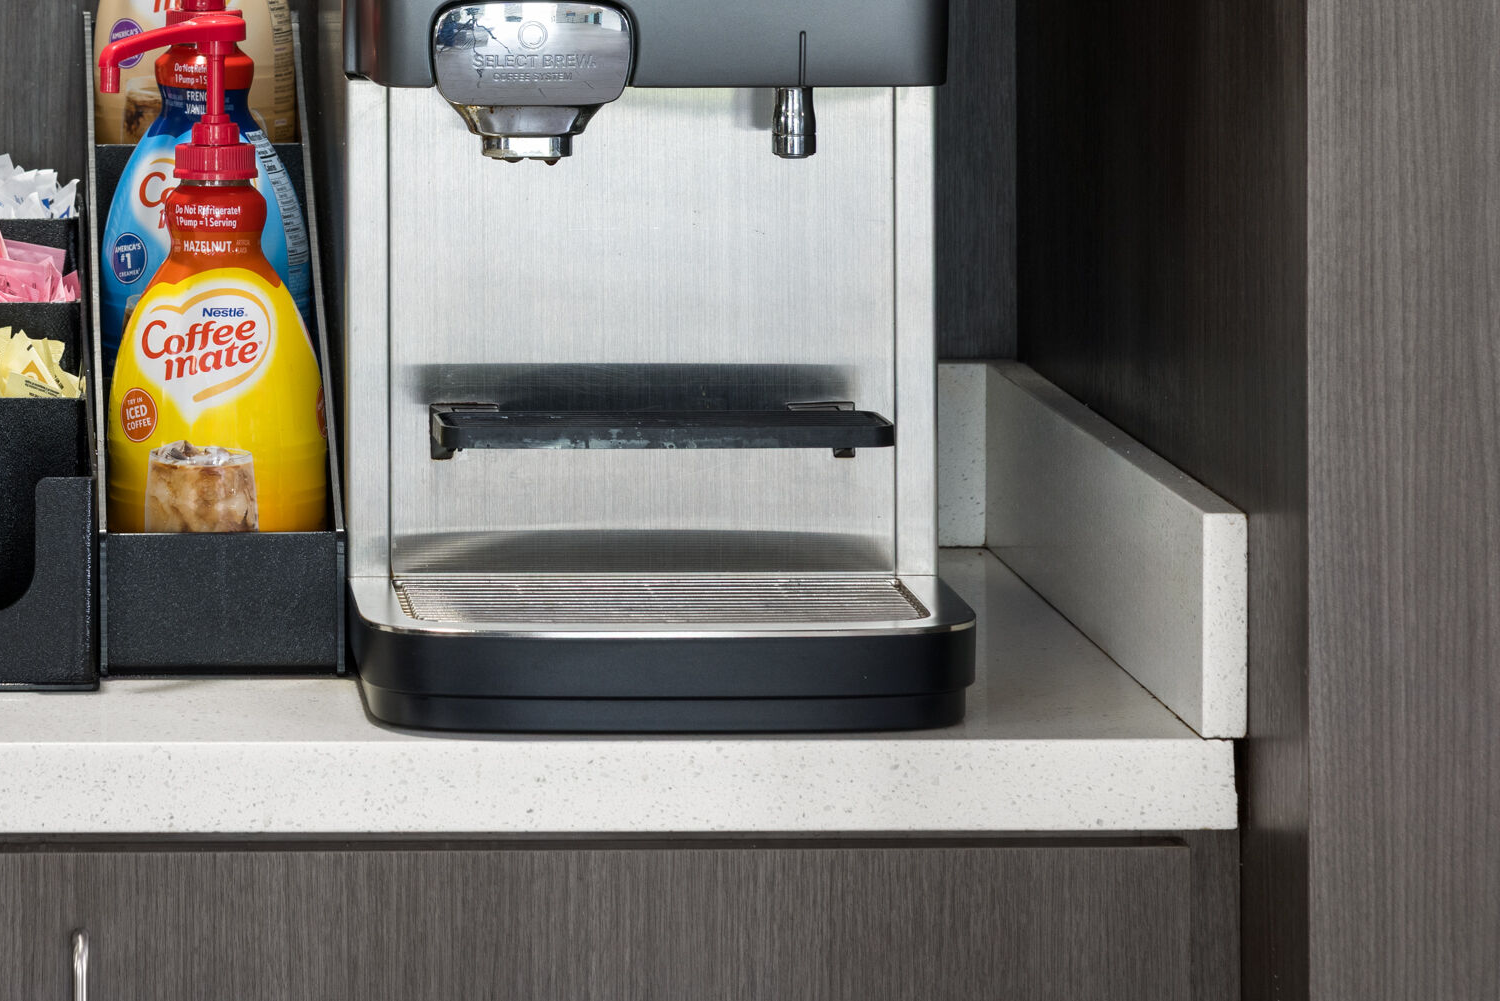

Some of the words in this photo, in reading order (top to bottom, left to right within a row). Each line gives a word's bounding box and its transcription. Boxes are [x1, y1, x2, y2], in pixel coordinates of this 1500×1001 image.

[174, 62, 183, 72] Do
[472, 54, 539, 69] SELECT
[542, 54, 594, 69] BREW
[179, 73, 195, 86] Pump
[493, 73, 531, 82] COFFEE
[533, 73, 573, 82] SYSTEM
[186, 90, 208, 102] FREN
[175, 204, 183, 214] Do
[184, 204, 197, 215] Not
[180, 217, 198, 229] Pump
[209, 217, 237, 229] Serving
[114, 242, 142, 254] AMERICA'S
[183, 240, 232, 253] HAZELNUT
[120, 252, 132, 269] #1
[202, 307, 245, 318] Nestlé
[141, 319, 257, 360] Coffee
[164, 341, 259, 381] mate
[127, 398, 136, 406] TRY
[125, 404, 148, 421] ICED
[126, 417, 152, 431] COFFEE
